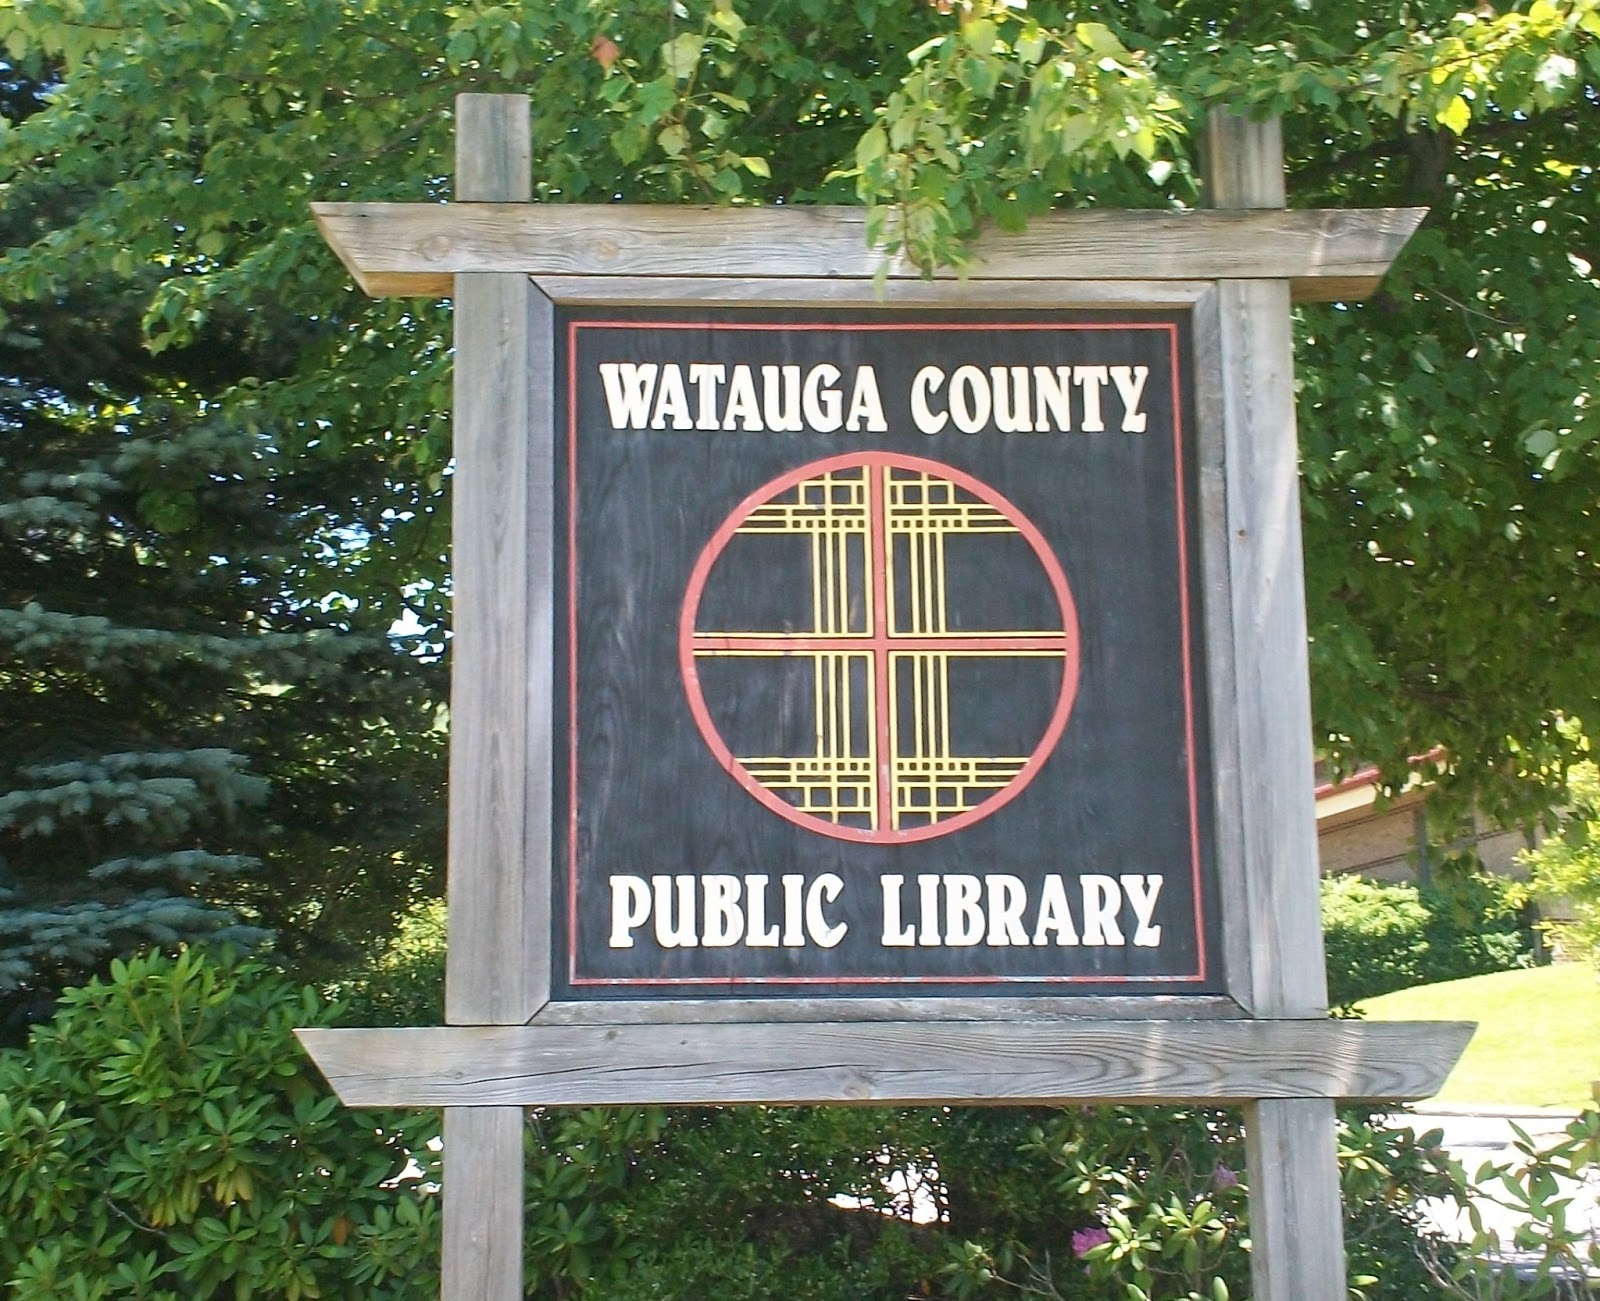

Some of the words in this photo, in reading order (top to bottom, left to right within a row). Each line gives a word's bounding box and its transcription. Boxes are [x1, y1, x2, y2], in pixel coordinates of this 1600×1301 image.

[599, 362, 888, 433] WATAUGA
[910, 365, 1150, 435] COUNTY
[608, 873, 848, 949] PUBLIC
[880, 873, 1164, 948] LIBRARY
